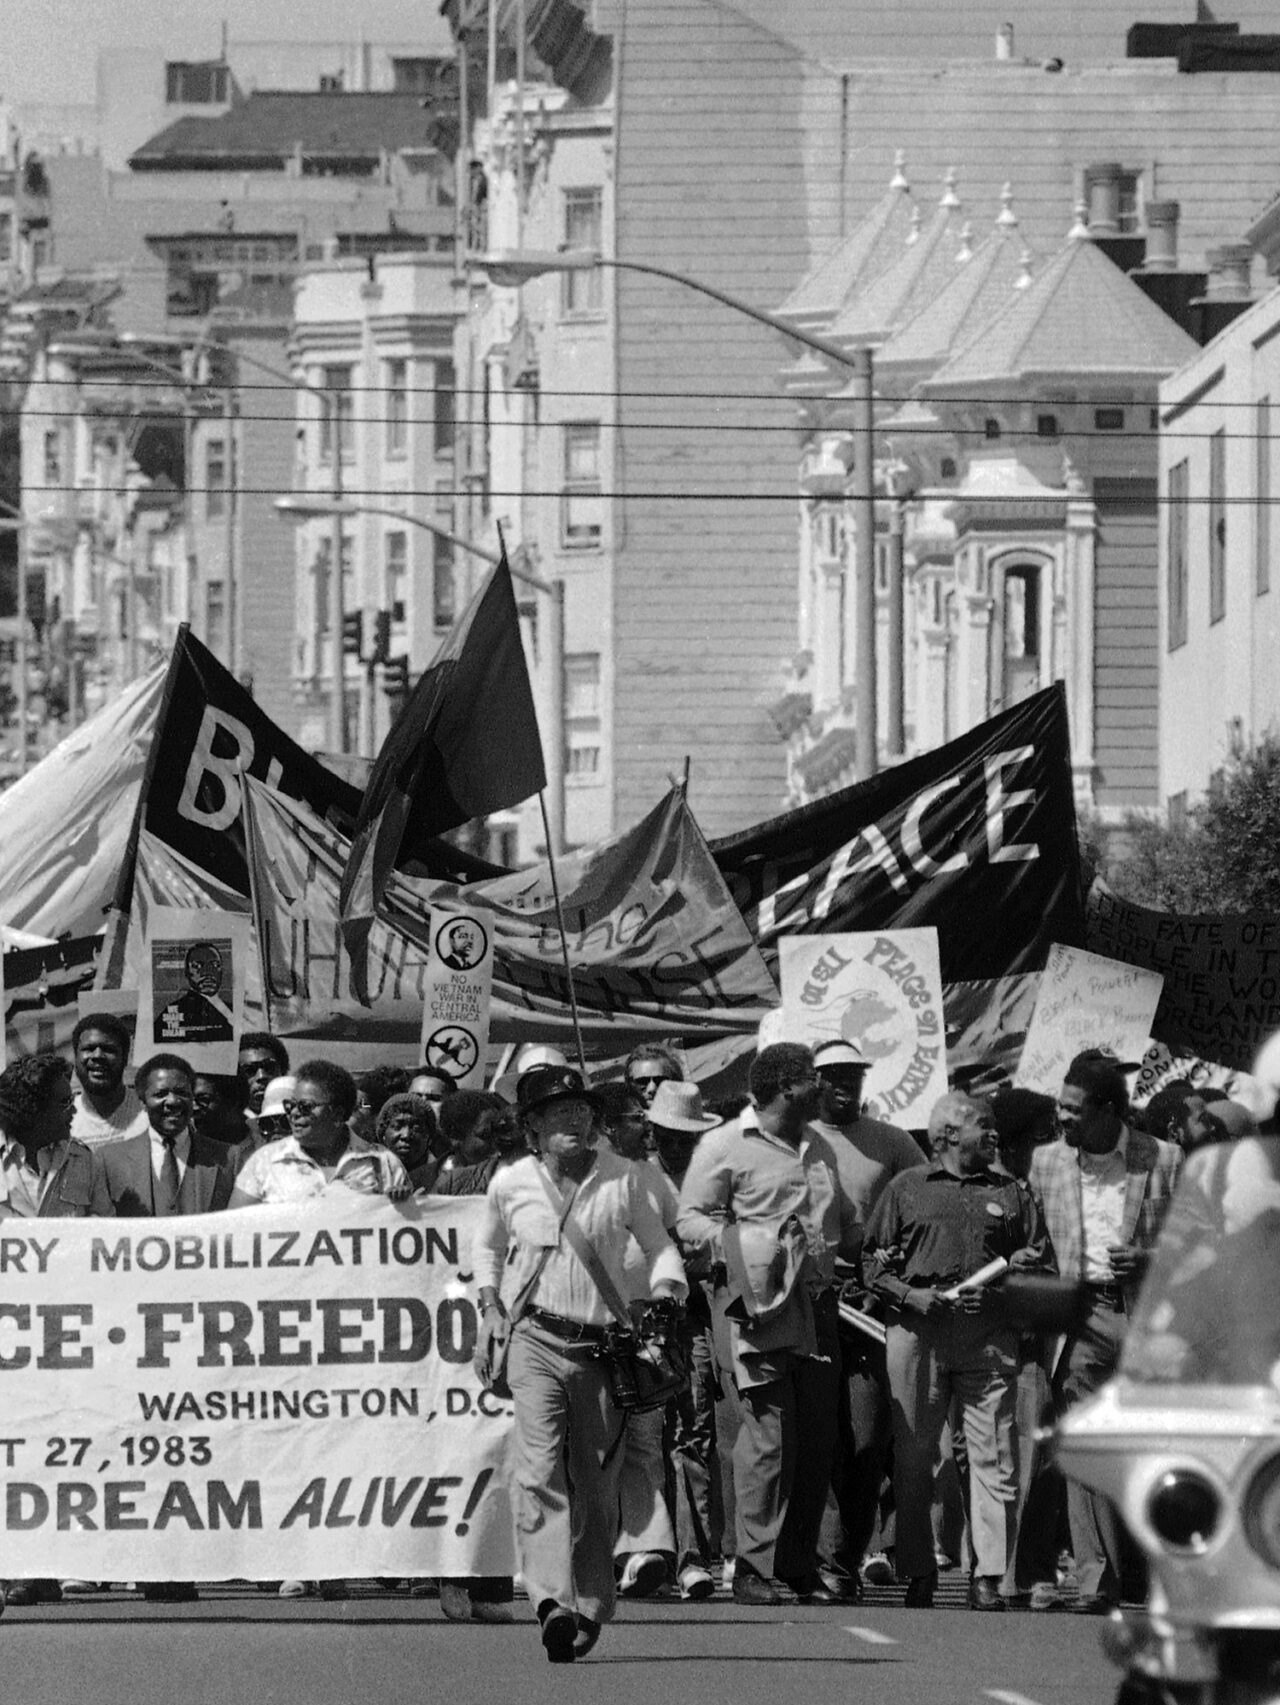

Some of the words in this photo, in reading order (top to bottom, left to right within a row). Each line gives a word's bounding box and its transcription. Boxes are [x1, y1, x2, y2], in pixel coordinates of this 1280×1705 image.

[1157, 920, 1224, 946] FATE
[1241, 922, 1277, 945] OF
[1208, 950, 1237, 973] IN
[451, 974, 467, 985] NO
[433, 983, 482, 995] VIETNAM
[440, 993, 463, 1001] WAR
[466, 994, 477, 1003] IN
[431, 1001, 482, 1014] CENTRAL
[432, 1011, 480, 1022] AMERICA
[90, 1226, 459, 1273] MOBILIZATION
[137, 1297, 482, 1369] FREEDO
[6, 1480, 264, 1532] DREAM
[279, 1468, 494, 1537] ALIVE!
